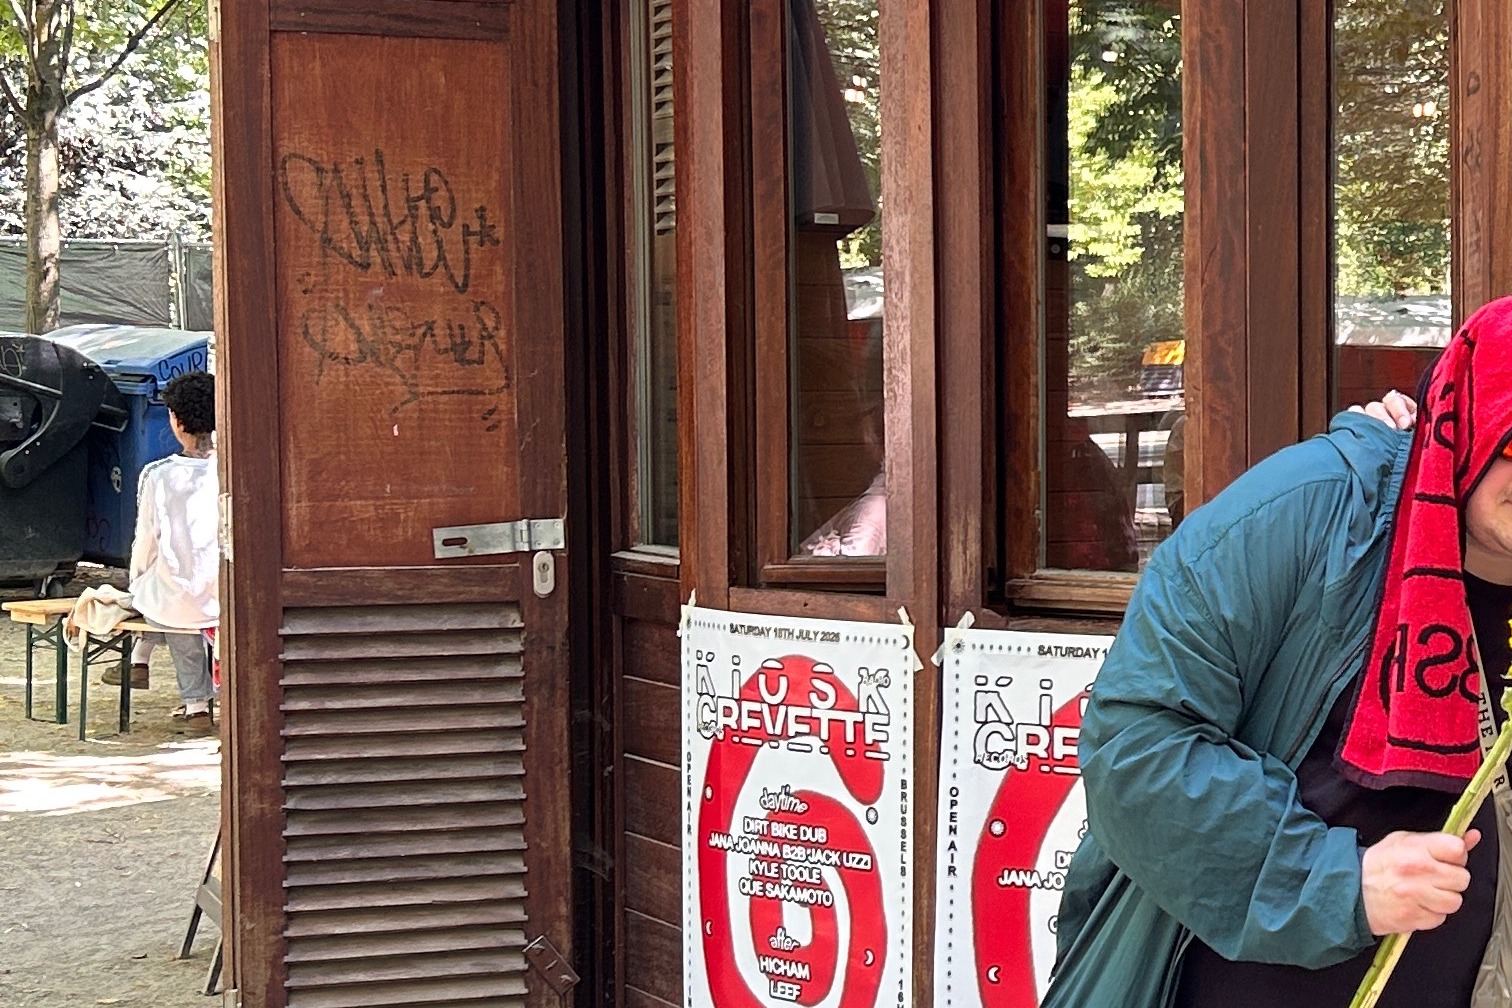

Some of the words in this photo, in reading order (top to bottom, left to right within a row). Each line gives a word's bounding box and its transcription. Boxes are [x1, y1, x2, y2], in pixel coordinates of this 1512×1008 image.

[730, 622, 772, 638] SATURDAY
[796, 629, 819, 641] JULY
[1037, 644, 1100, 659] SATURDAY
[696, 694, 891, 760] CREVETTE
[1478, 693, 1494, 738] THE
[760, 784, 809, 814] daytime
[948, 786, 959, 836] OPEN
[743, 816, 770, 836] DIRT
[770, 820, 798, 841] BIKE
[799, 825, 828, 844] DUB
[900, 779, 908, 876] BRUSSELS
[708, 831, 734, 851] JANA
[734, 836, 782, 860] JOANNA
[782, 843, 807, 862] B2B
[947, 840, 957, 877] AIR
[749, 858, 780, 878] KYLE
[781, 862, 821, 885] TOOLE
[997, 868, 1042, 889] JANA
[739, 876, 765, 896] QUE
[765, 882, 834, 907] SAKAMOTO
[768, 926, 801, 953] after
[760, 954, 812, 982] HICHAM
[769, 979, 802, 1003] LEEF
